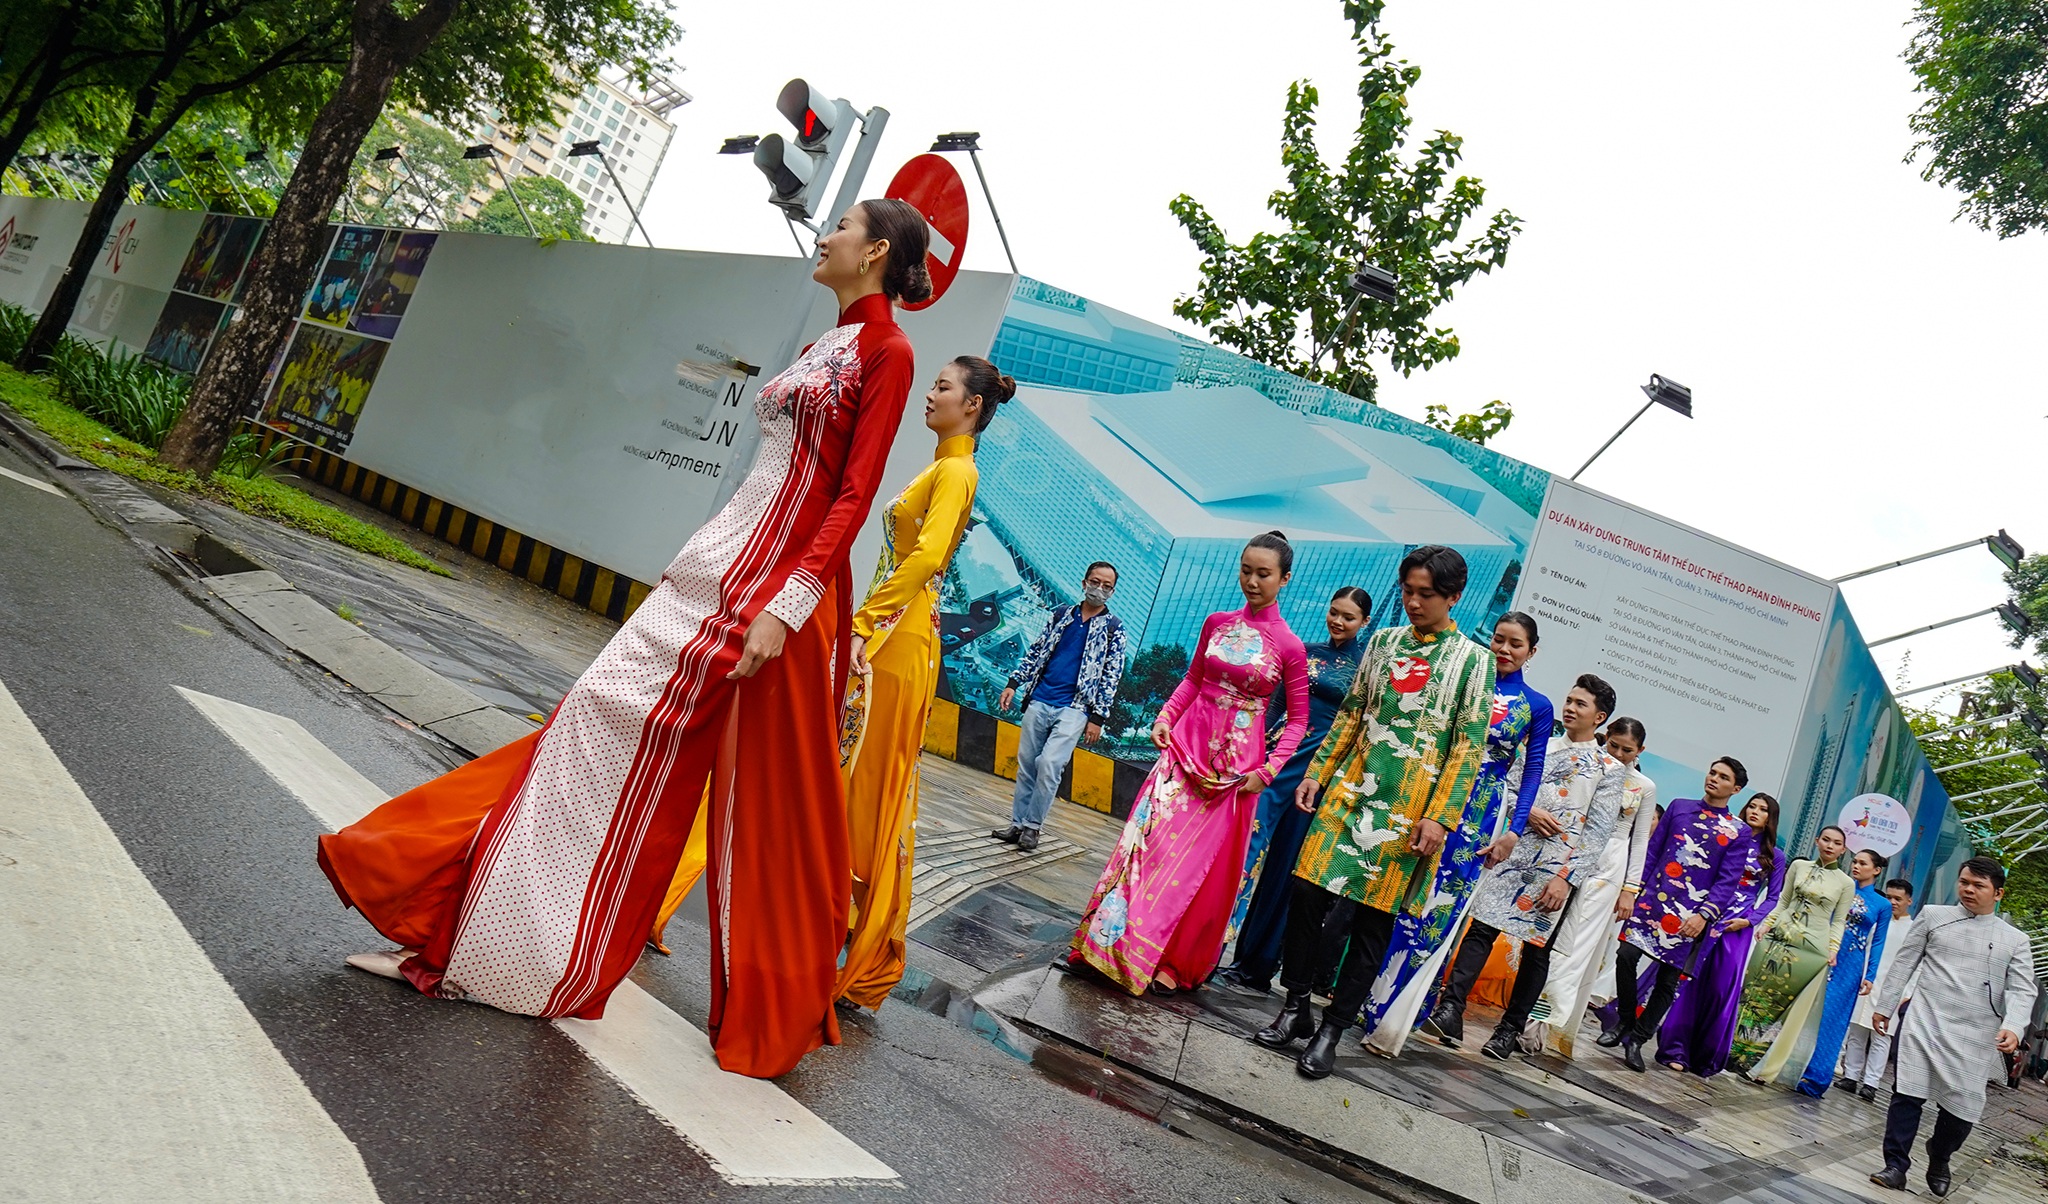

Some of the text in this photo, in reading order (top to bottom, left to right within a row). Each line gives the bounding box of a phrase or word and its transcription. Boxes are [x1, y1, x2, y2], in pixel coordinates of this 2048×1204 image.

[1548, 510, 1822, 623] DỰ ÁN XÂY DỰNG TRUNG TÂM THỂ DỤC THỂ THAO PHAN ĐÌNH PHÙNG
[1550, 569, 1588, 590] TÊN DỰ ÁN:
[1586, 543, 1596, 554] SỐ
[1596, 548, 1602, 556] 8
[1602, 550, 1631, 568] ĐƯỜNG
[1632, 560, 1643, 572] VÕ
[1675, 577, 1696, 592] QUẬN
[1696, 586, 1702, 596] 3,
[1703, 588, 1729, 604] THÀNH
[1728, 597, 1744, 611] PHỐ
[1745, 604, 1756, 615] HỒ
[1757, 610, 1770, 621] CHÍ
[1770, 614, 1789, 628] MINH
[1541, 595, 1558, 607] ĐƠN
[1558, 602, 1566, 612] VỊ
[1538, 610, 1552, 620] NHÀ
[1616, 595, 1630, 606] XÂY
[1649, 606, 1671, 621] TRUNG
[1671, 615, 1684, 626] TÂM
[1722, 634, 1740, 647] THAO
[1739, 641, 1757, 654] PHAN
[1619, 639, 1639, 652] DANH
[1606, 649, 1626, 662] CÔNG
[1627, 656, 1635, 664] TY
[1665, 641, 1682, 654] THAO
[1682, 648, 1704, 662] THÀNH
[1739, 670, 1757, 681] MINH
[1723, 649, 1745, 663] THÀNH
[1780, 671, 1798, 682] MINH
[1621, 668, 1640, 682] CÔNG
[1640, 676, 1648, 684] TY
